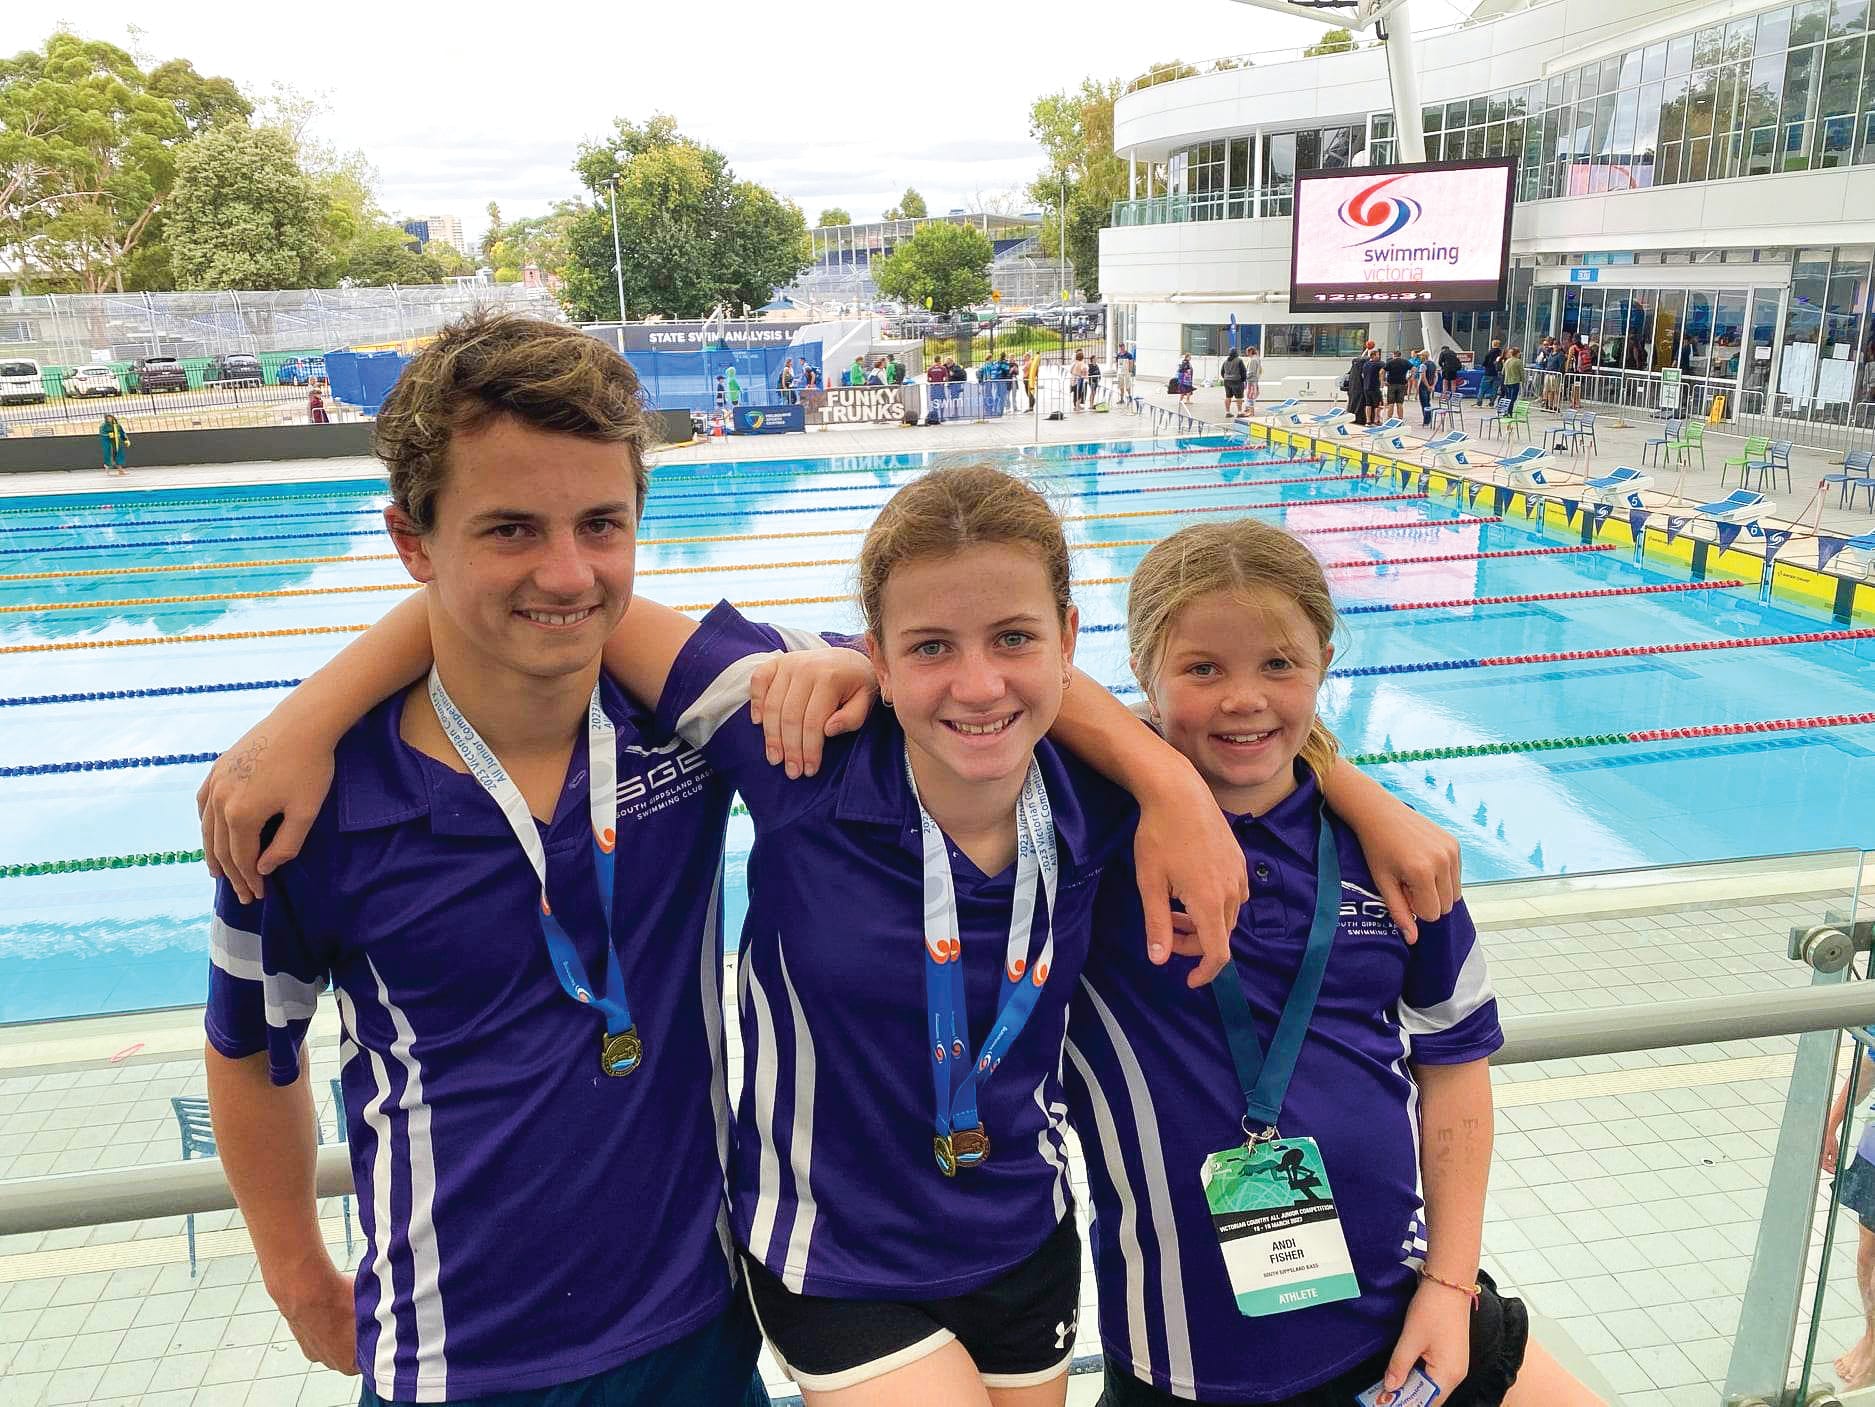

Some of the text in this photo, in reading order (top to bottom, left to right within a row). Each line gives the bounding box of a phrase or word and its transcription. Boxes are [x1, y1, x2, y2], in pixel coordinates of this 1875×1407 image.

[1364, 242, 1459, 265] swimming
[1364, 264, 1424, 281] victoria
[649, 332, 685, 343] STATE
[724, 330, 783, 342] ANALYSIS
[827, 388, 899, 407] FUNKY
[818, 403, 905, 423] TRUNKS
[437, 685, 507, 783] All Junior Competition
[450, 729, 479, 770] Victorian
[477, 769, 497, 790] 2023
[636, 784, 704, 820] SWIMMING CLUB
[1029, 802, 1044, 849] Victorian
[1045, 820, 1055, 850] Junior
[1019, 833, 1029, 858] 2023
[1040, 848, 1051, 872] 2023
[1219, 1203, 1334, 1233] VICTORIAN COUNTRY ALL JUNIOR COMPETITION
[1271, 1219, 1291, 1229] MARCH
[1272, 1237, 1297, 1252] ANDI
[1269, 1249, 1305, 1264] FISHER
[1279, 1287, 1319, 1304] ATHLETE
